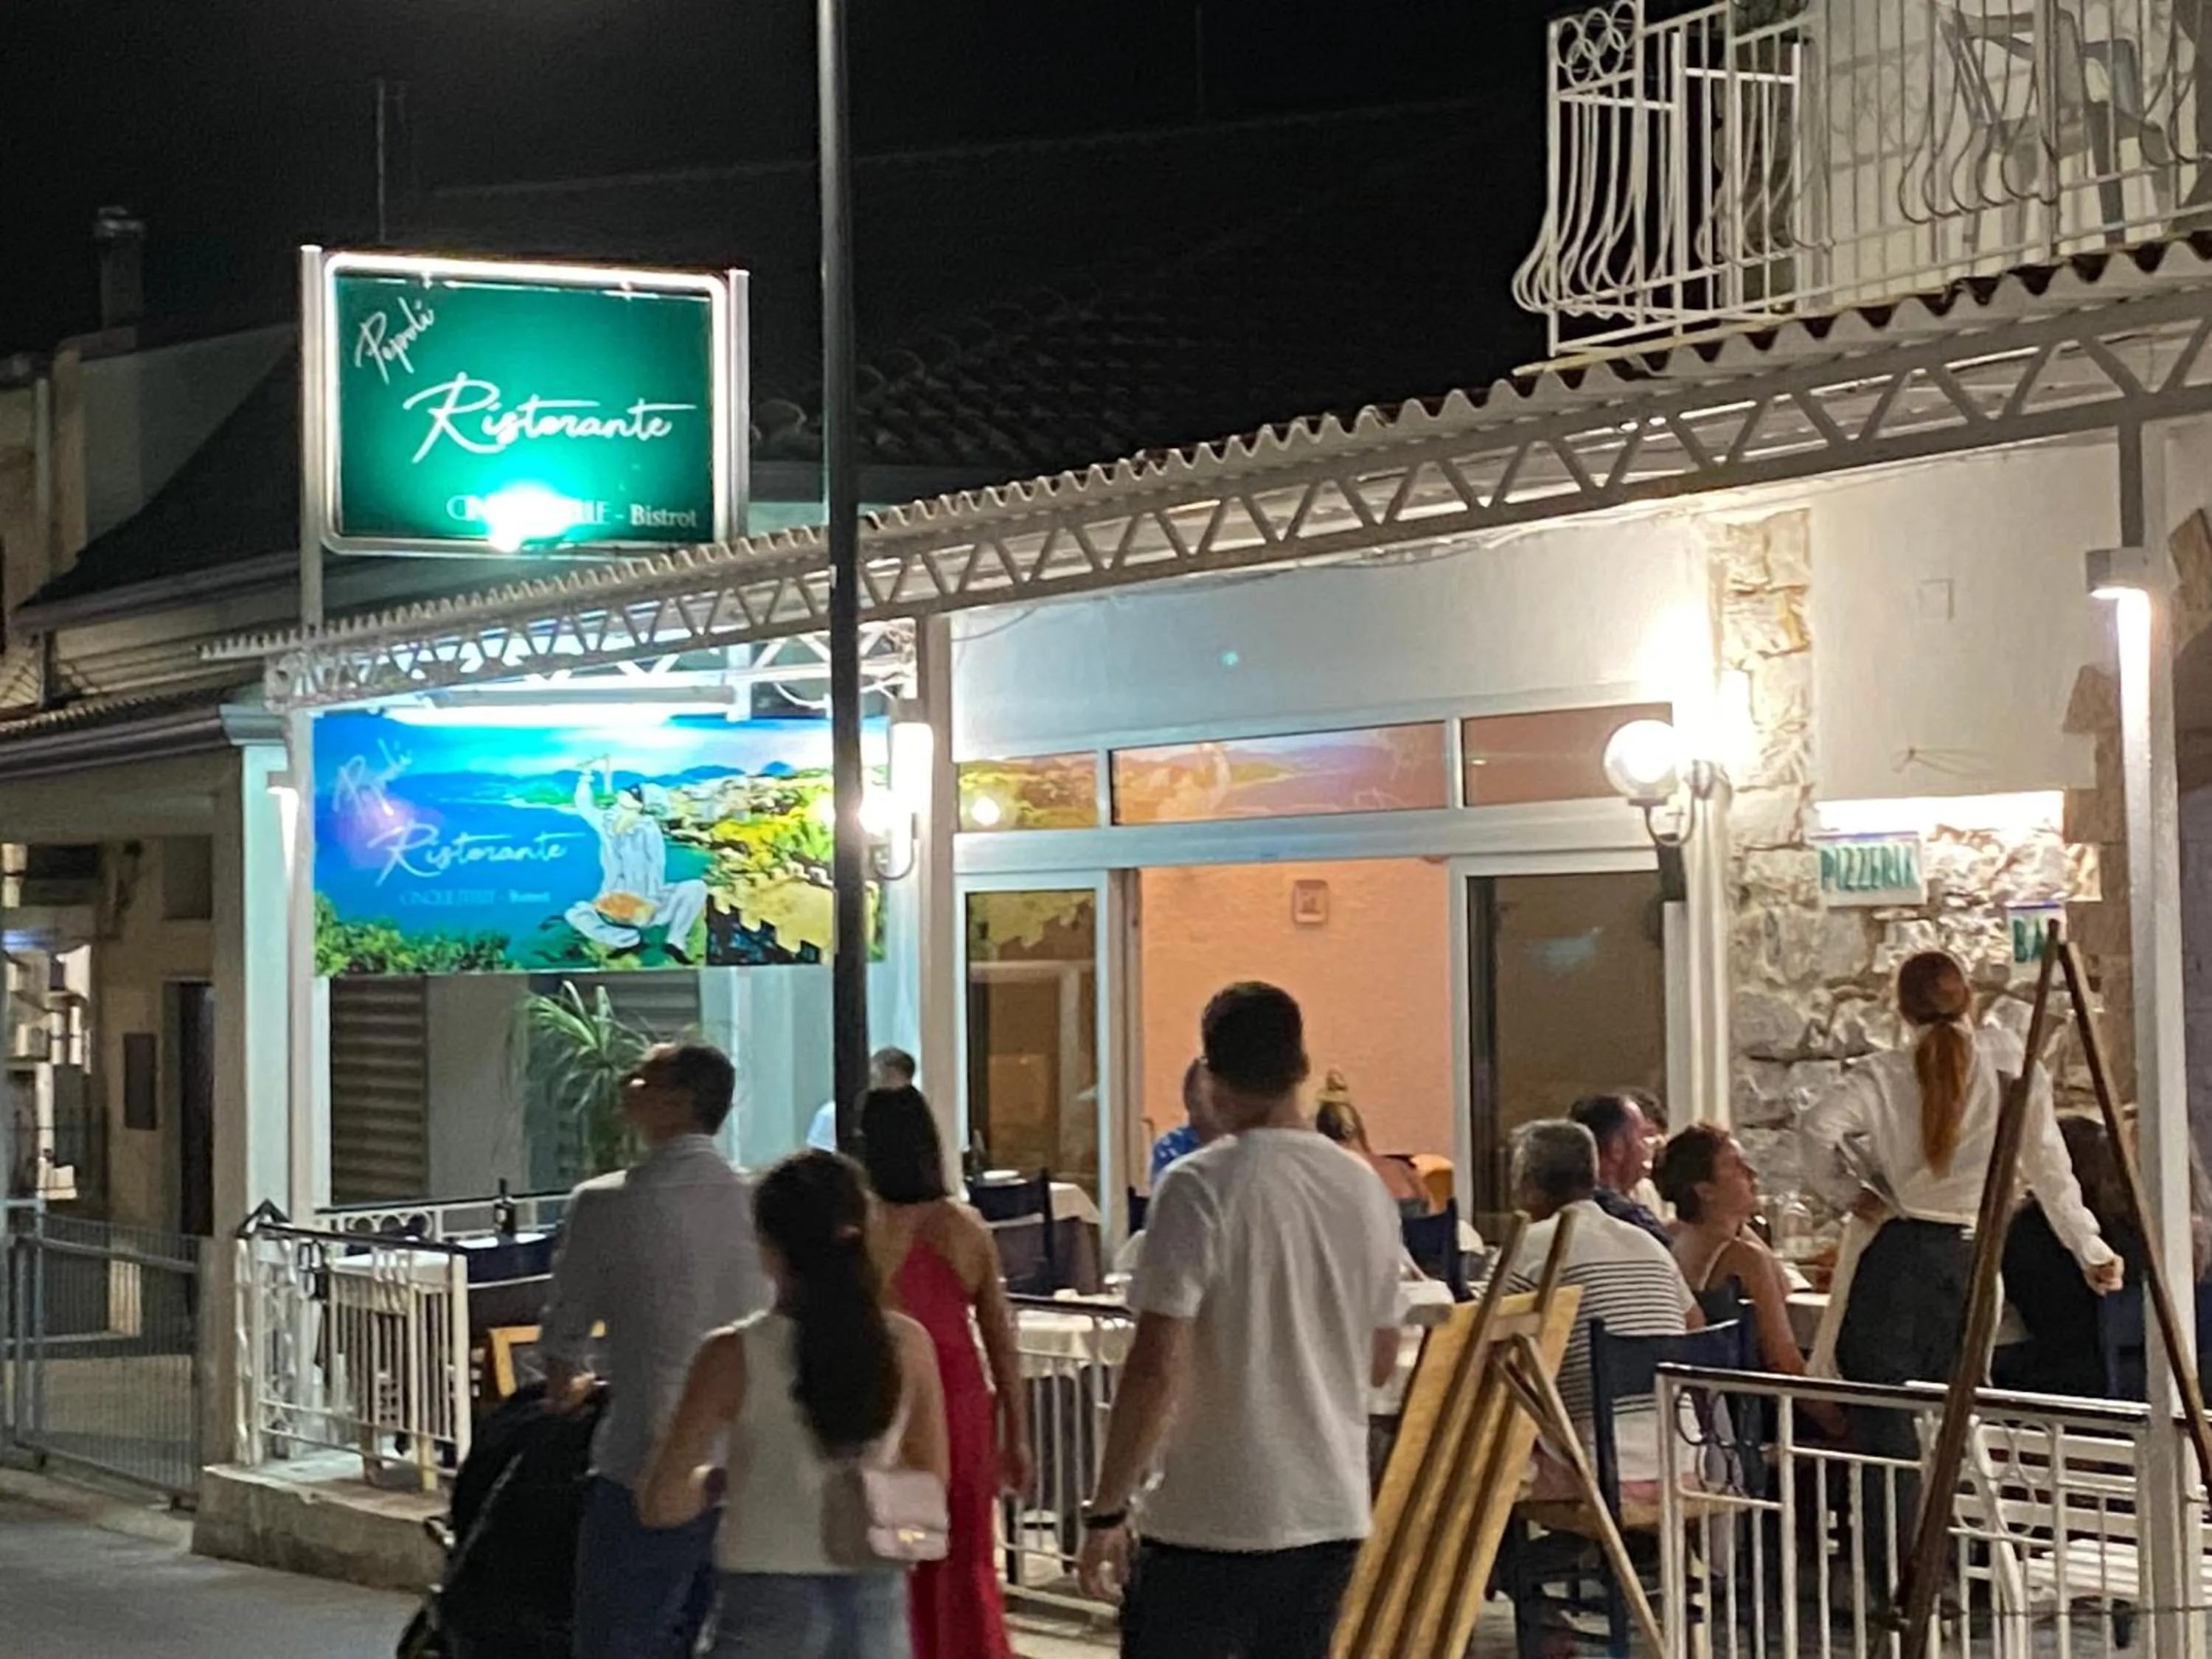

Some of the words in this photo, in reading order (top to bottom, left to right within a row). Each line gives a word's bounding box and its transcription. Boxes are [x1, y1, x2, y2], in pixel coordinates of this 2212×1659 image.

[402, 371, 697, 464] Ristorante
[630, 503, 697, 527] Bistrot
[367, 819, 586, 887] Ristorante
[1820, 844, 1919, 892] PIZZERIA
